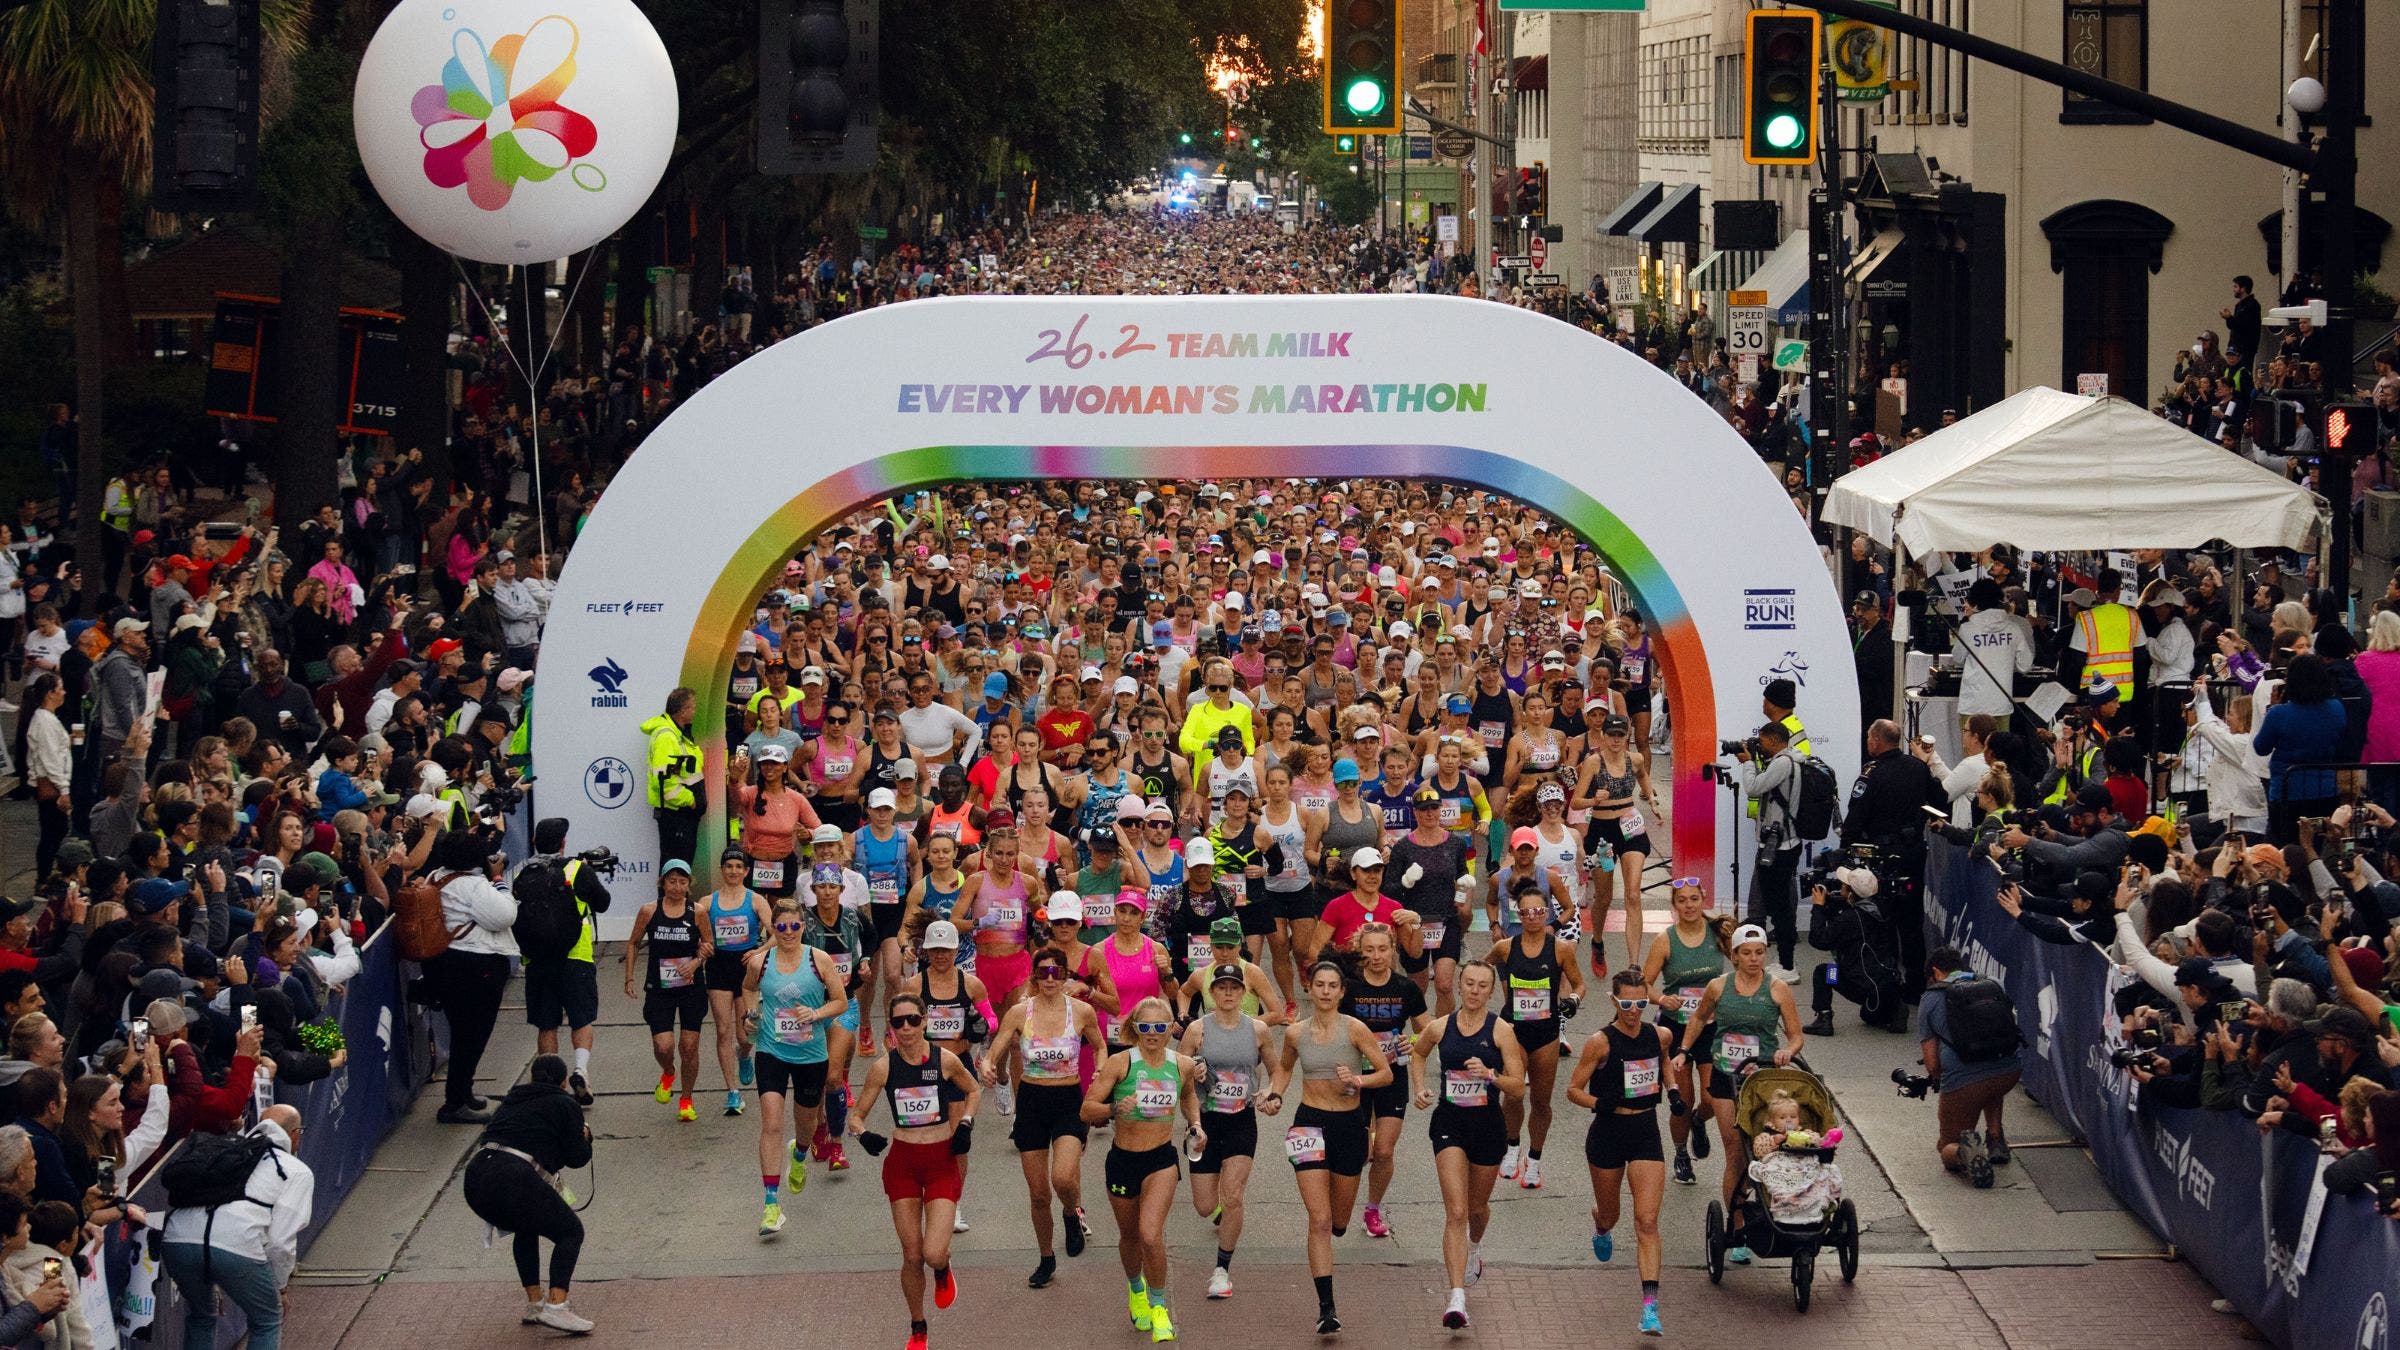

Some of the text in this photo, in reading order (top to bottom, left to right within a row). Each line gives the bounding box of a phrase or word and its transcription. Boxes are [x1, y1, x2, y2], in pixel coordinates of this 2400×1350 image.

[1850, 89, 1883, 98] VERN
[1732, 311, 1763, 320] SPEED
[1026, 313, 1353, 369] 26.2 TEAM MILK
[1733, 331, 1763, 348] 30
[898, 383, 1487, 414] EVERY WOMAN'S MARATHON
[353, 403, 396, 416] 3715
[1953, 579, 1971, 589] RUN
[1745, 597, 1795, 605] BLACK GIRLS
[586, 603, 664, 613] FLEET FEET
[1746, 605, 1795, 621] RUN!
[1973, 632, 2013, 648] STAFF
[591, 695, 628, 708] rabbit
[1483, 727, 1502, 736] 3999
[1808, 735, 1829, 745] orgia
[1535, 753, 1555, 762] 7804
[590, 759, 627, 775] BMW
[830, 765, 849, 773] 3421
[1306, 798, 1325, 808] 3612
[1384, 808, 1405, 823] 261
[1441, 809, 1457, 818] 371
[1624, 816, 1642, 832] 3760
[757, 871, 780, 880] 6076
[873, 881, 896, 890] 5884
[1002, 910, 1016, 920] 113
[1086, 905, 1111, 915] 7920
[656, 925, 688, 934] NEW YORK
[720, 926, 745, 935] 7202
[654, 932, 690, 941] HARRIERS
[1193, 946, 1211, 956] 209
[835, 964, 848, 973] 20
[962, 961, 975, 970] 80
[1354, 997, 1391, 1005] TOGETHER
[1520, 999, 1544, 1010] 8147
[1684, 1000, 1699, 1010] 45
[1355, 1004, 1403, 1018] RISE
[781, 1020, 801, 1031] 823
[932, 1021, 959, 1031] 5893
[1034, 1050, 1064, 1061] 3386
[1728, 1046, 1752, 1058] 5715
[1630, 1071, 1655, 1085] 5393
[1215, 1084, 1243, 1097] 5428
[1451, 1083, 1480, 1094] 7077
[1141, 1094, 1172, 1105] 4422
[904, 1100, 930, 1112] 1567
[1292, 1138, 1317, 1151] 1547
[2188, 1156, 2215, 1210] FEET
